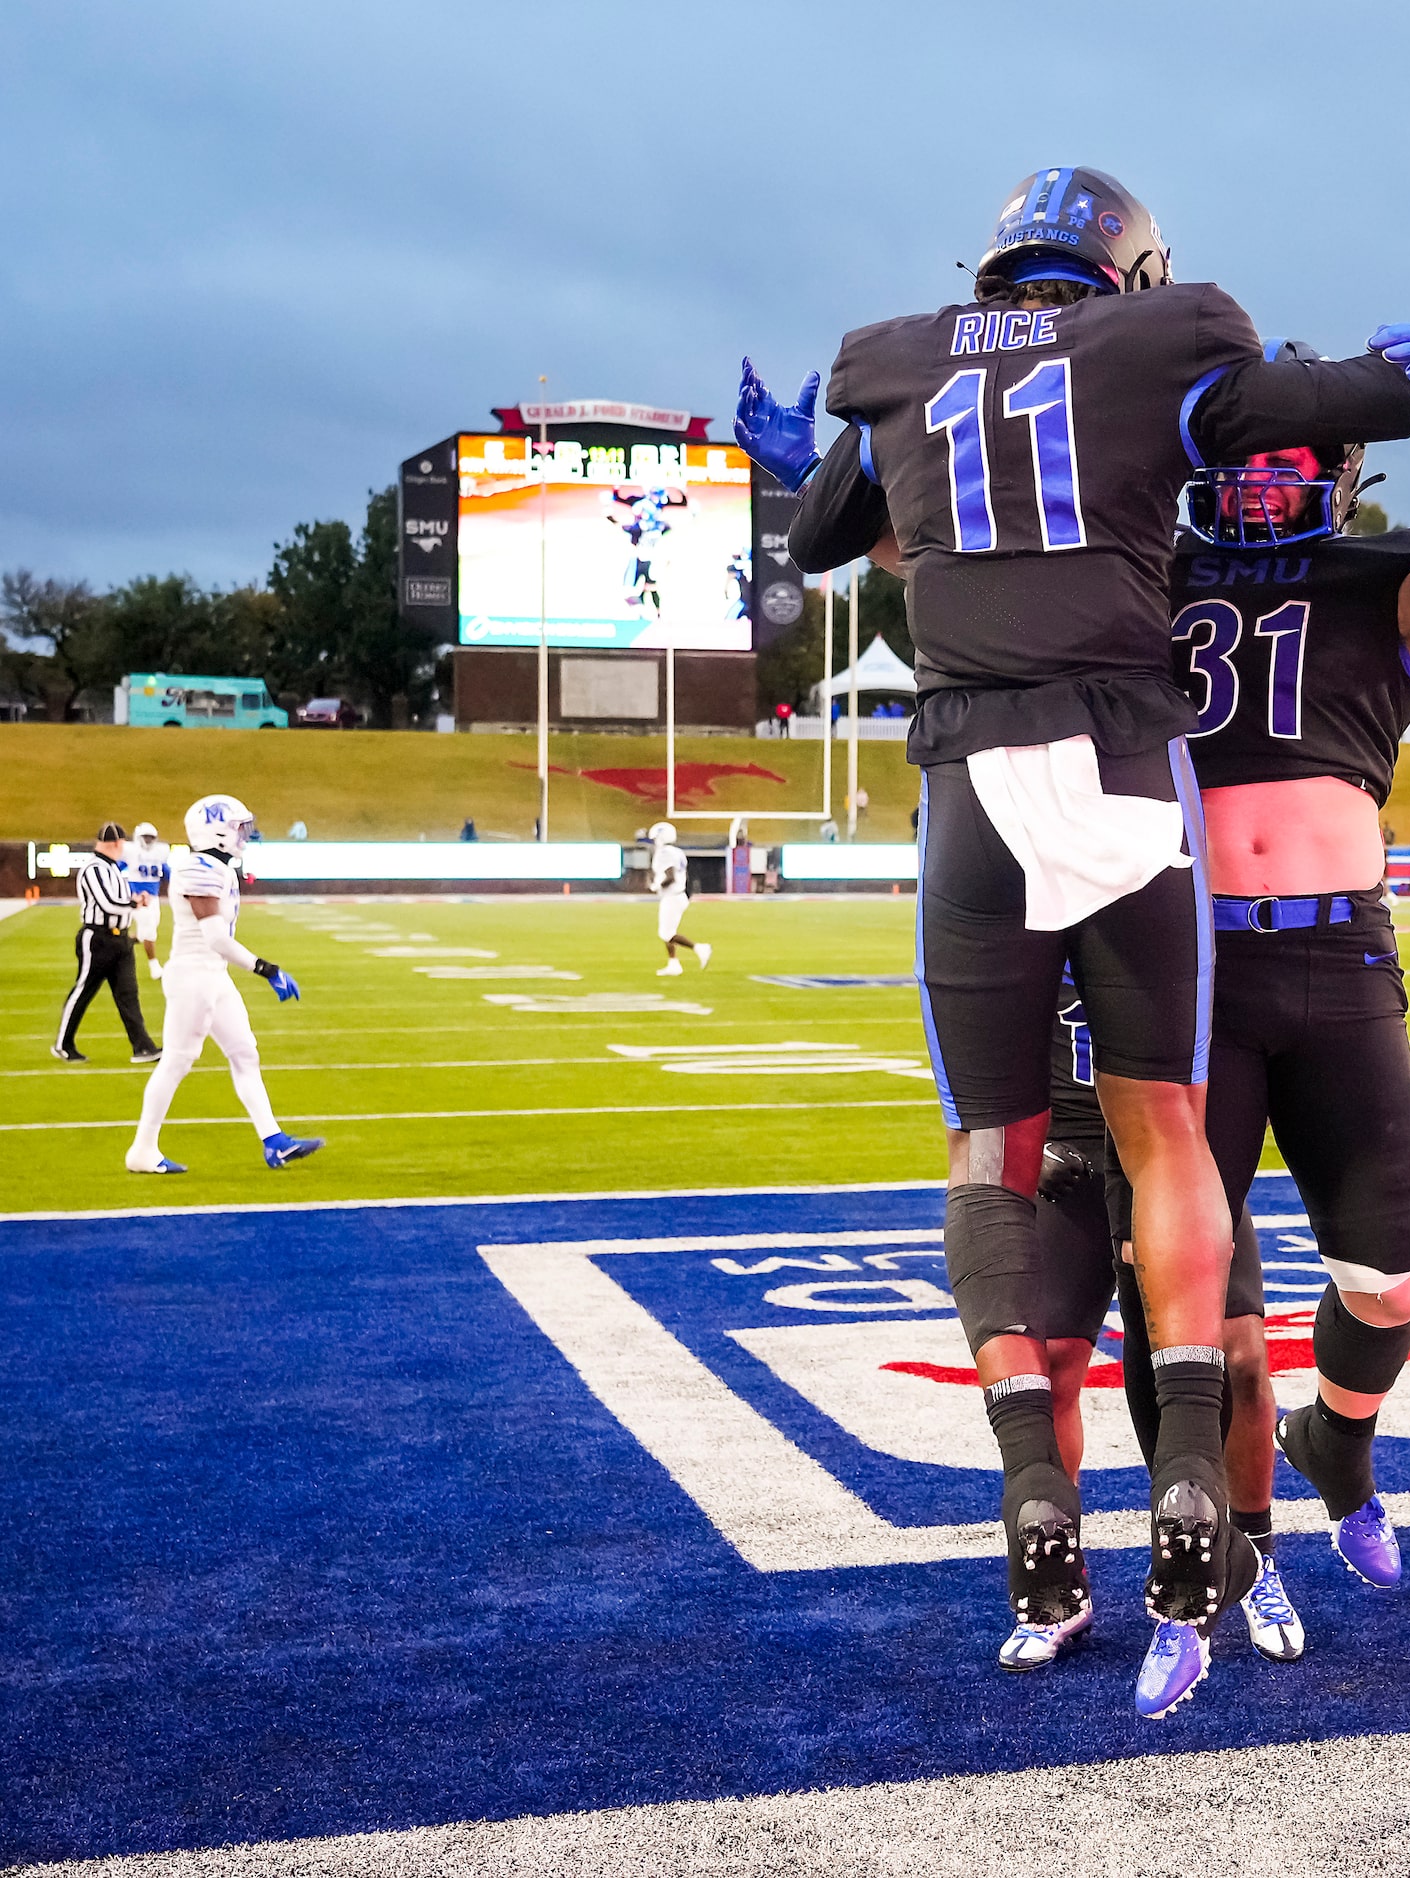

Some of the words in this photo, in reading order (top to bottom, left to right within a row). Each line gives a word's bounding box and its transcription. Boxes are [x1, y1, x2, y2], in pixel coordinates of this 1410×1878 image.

[996, 228, 1080, 254] MUSTANGS
[950, 308, 1062, 356] RICE
[924, 357, 1088, 553] 11
[405, 519, 449, 535] SMU
[761, 533, 789, 549] SM
[1187, 556, 1313, 587] SMU
[1171, 598, 1311, 739] 31
[205, 805, 226, 825] M
